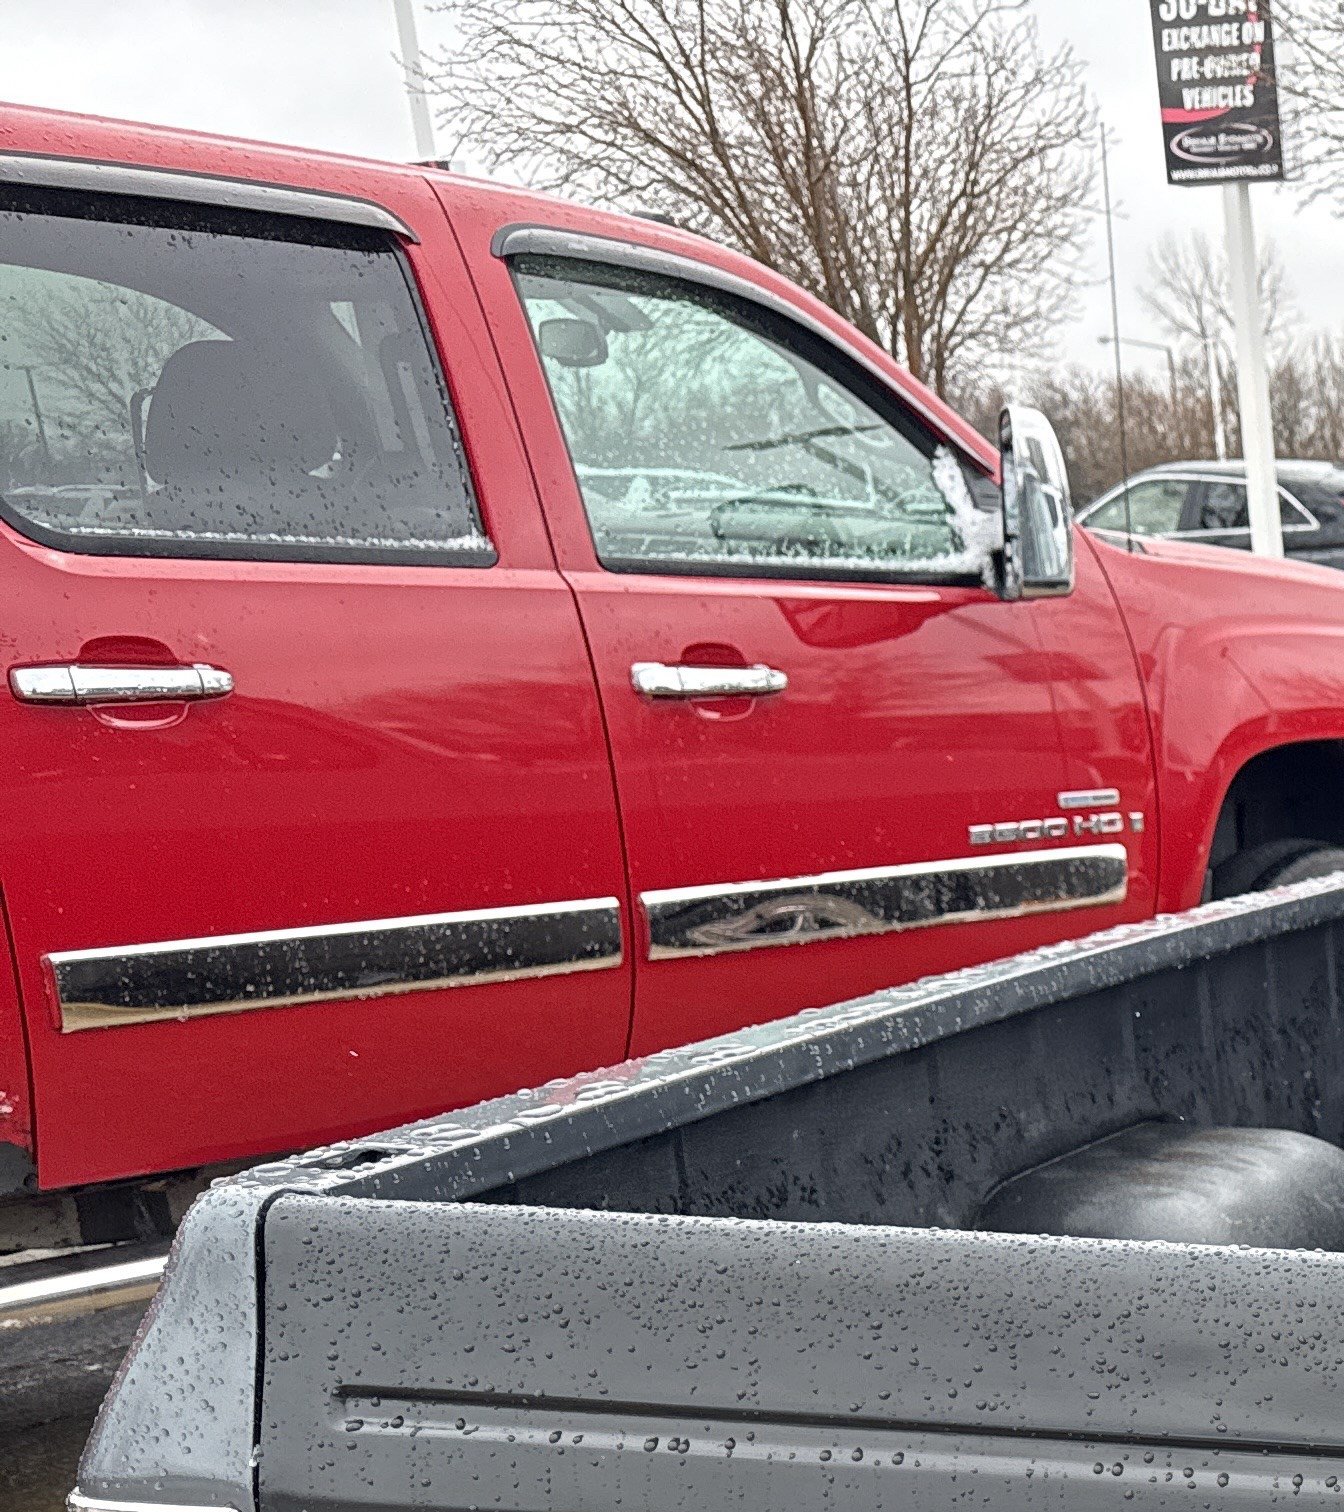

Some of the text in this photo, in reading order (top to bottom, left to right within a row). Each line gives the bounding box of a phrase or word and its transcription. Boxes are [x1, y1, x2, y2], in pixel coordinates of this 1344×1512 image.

[1161, 21, 1265, 51] EXCHANGE ON
[1182, 84, 1254, 109] VEHICLES
